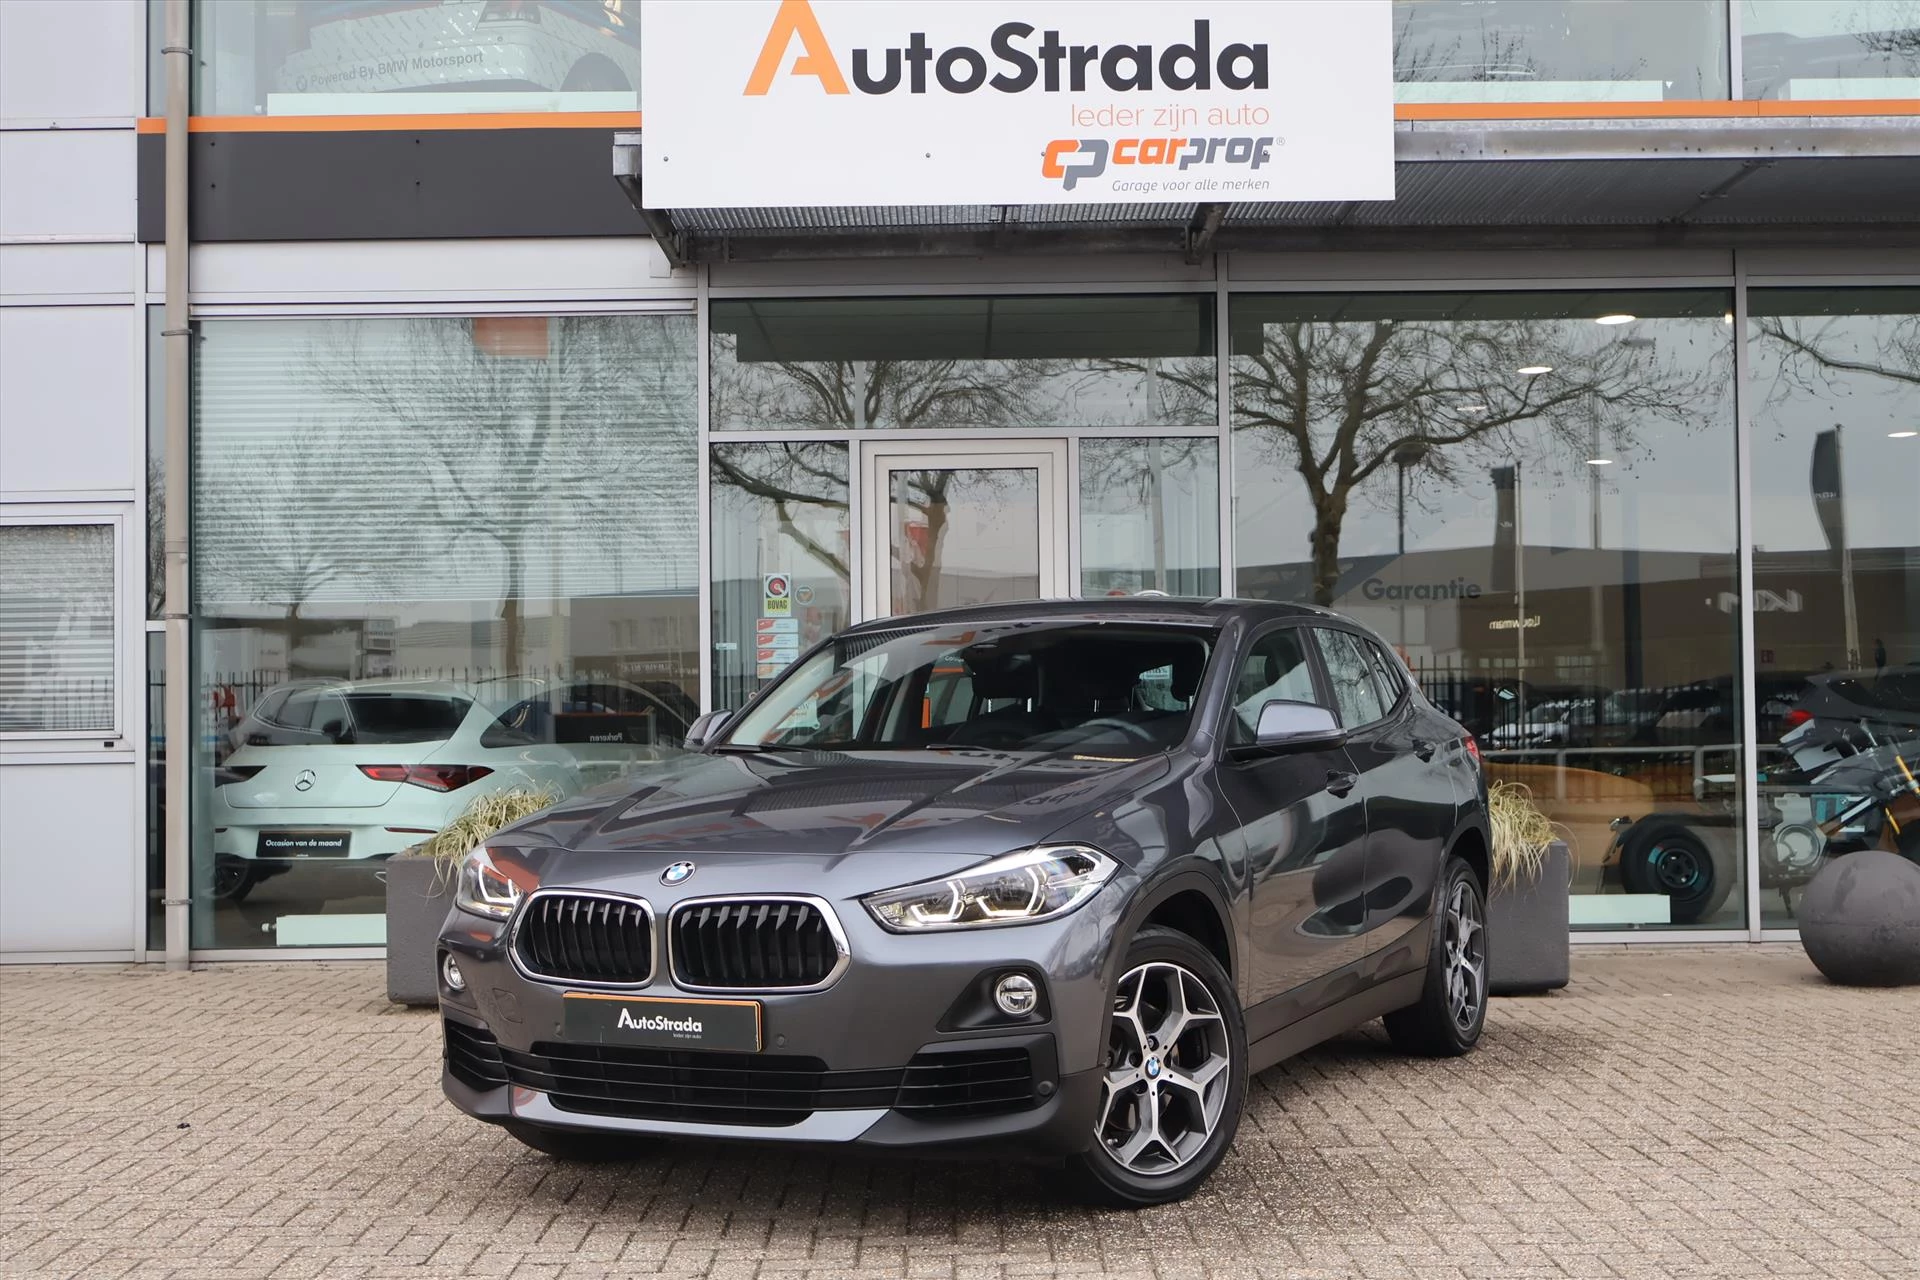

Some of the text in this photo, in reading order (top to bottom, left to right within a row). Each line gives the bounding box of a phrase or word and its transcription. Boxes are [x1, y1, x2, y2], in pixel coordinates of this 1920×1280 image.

[743, 0, 1269, 96] AutoStrada
[310, 52, 484, 86] Powered By BMW Motorsport
[1071, 104, 1270, 132] Ieder zijn auto
[1111, 137, 1274, 171] carprof
[1112, 178, 1270, 194] Garage voor alle merken
[1362, 577, 1482, 601] Garantie
[767, 599, 788, 610] BOVAG
[265, 839, 294, 847] Occasion
[308, 839, 317, 847] de
[318, 839, 343, 847] maand
[617, 1007, 702, 1032] AutoStrada
